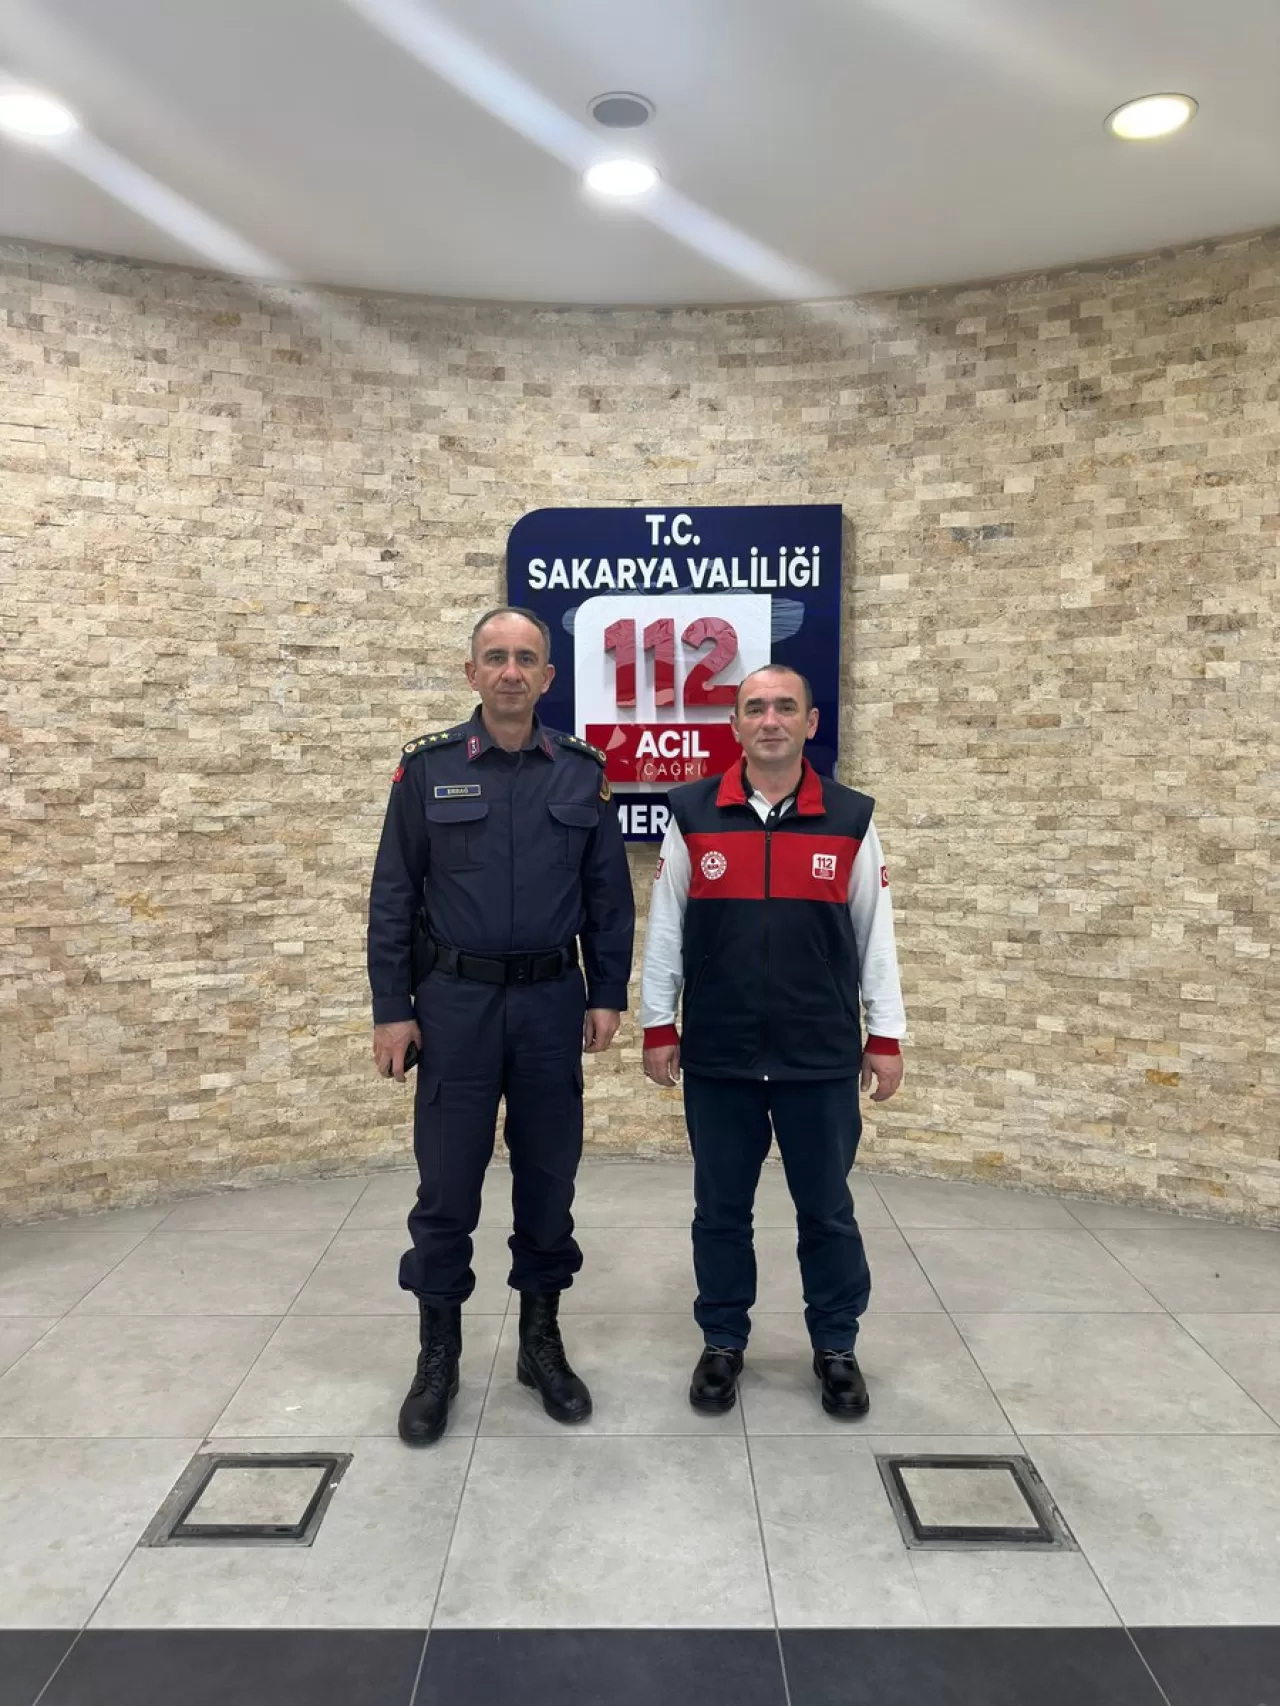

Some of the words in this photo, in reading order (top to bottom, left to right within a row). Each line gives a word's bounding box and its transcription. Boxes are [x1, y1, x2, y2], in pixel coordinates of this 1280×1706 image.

[645, 514, 701, 546] T.C.
[528, 558, 678, 590] SAKARYA
[687, 545, 821, 588] VALİLİĞİ
[604, 616, 739, 709] 112
[816, 856, 833, 869] 112
